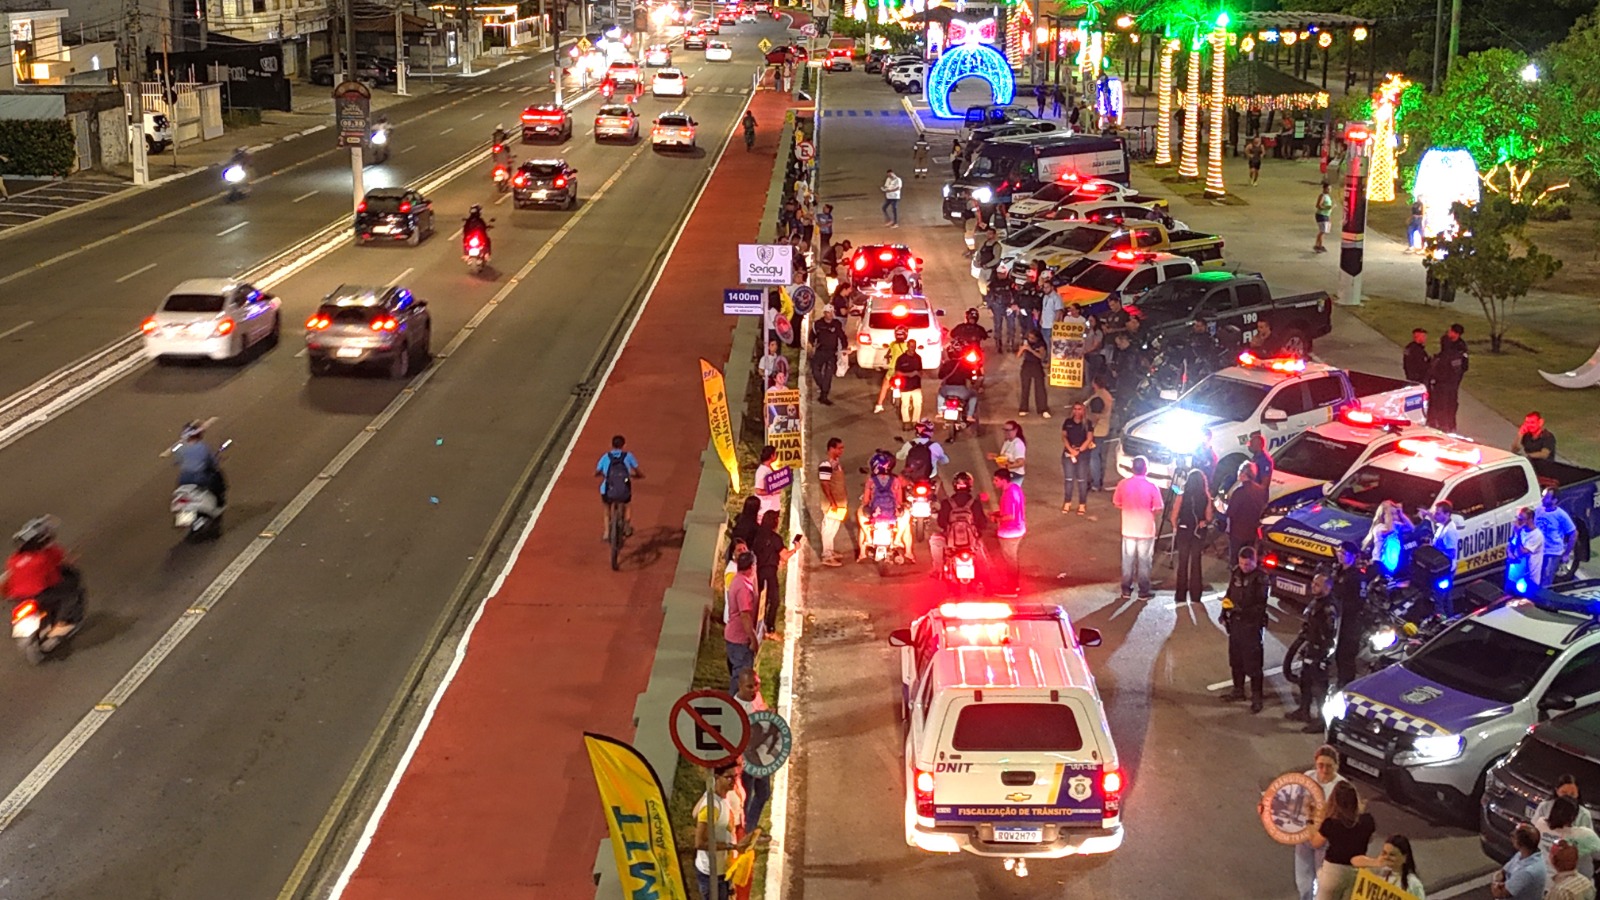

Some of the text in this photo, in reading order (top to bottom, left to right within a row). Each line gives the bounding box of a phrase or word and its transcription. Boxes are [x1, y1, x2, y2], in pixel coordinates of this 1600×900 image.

[1243, 313, 1257, 324] 190
[1052, 373, 1081, 381] GRANDE
[769, 439, 801, 449] UMA
[1457, 528, 1494, 560] POLÍCIA
[1466, 545, 1506, 569] TRÂNS
[694, 707, 724, 750] E
[754, 712, 788, 735] RESPEITO
[935, 763, 974, 773] DNIT
[958, 806, 1017, 818] FISCALIZAÇÃO
[1019, 807, 1030, 816] DE
[1032, 806, 1073, 816] TRÂNSITO
[1356, 877, 1366, 896] A
